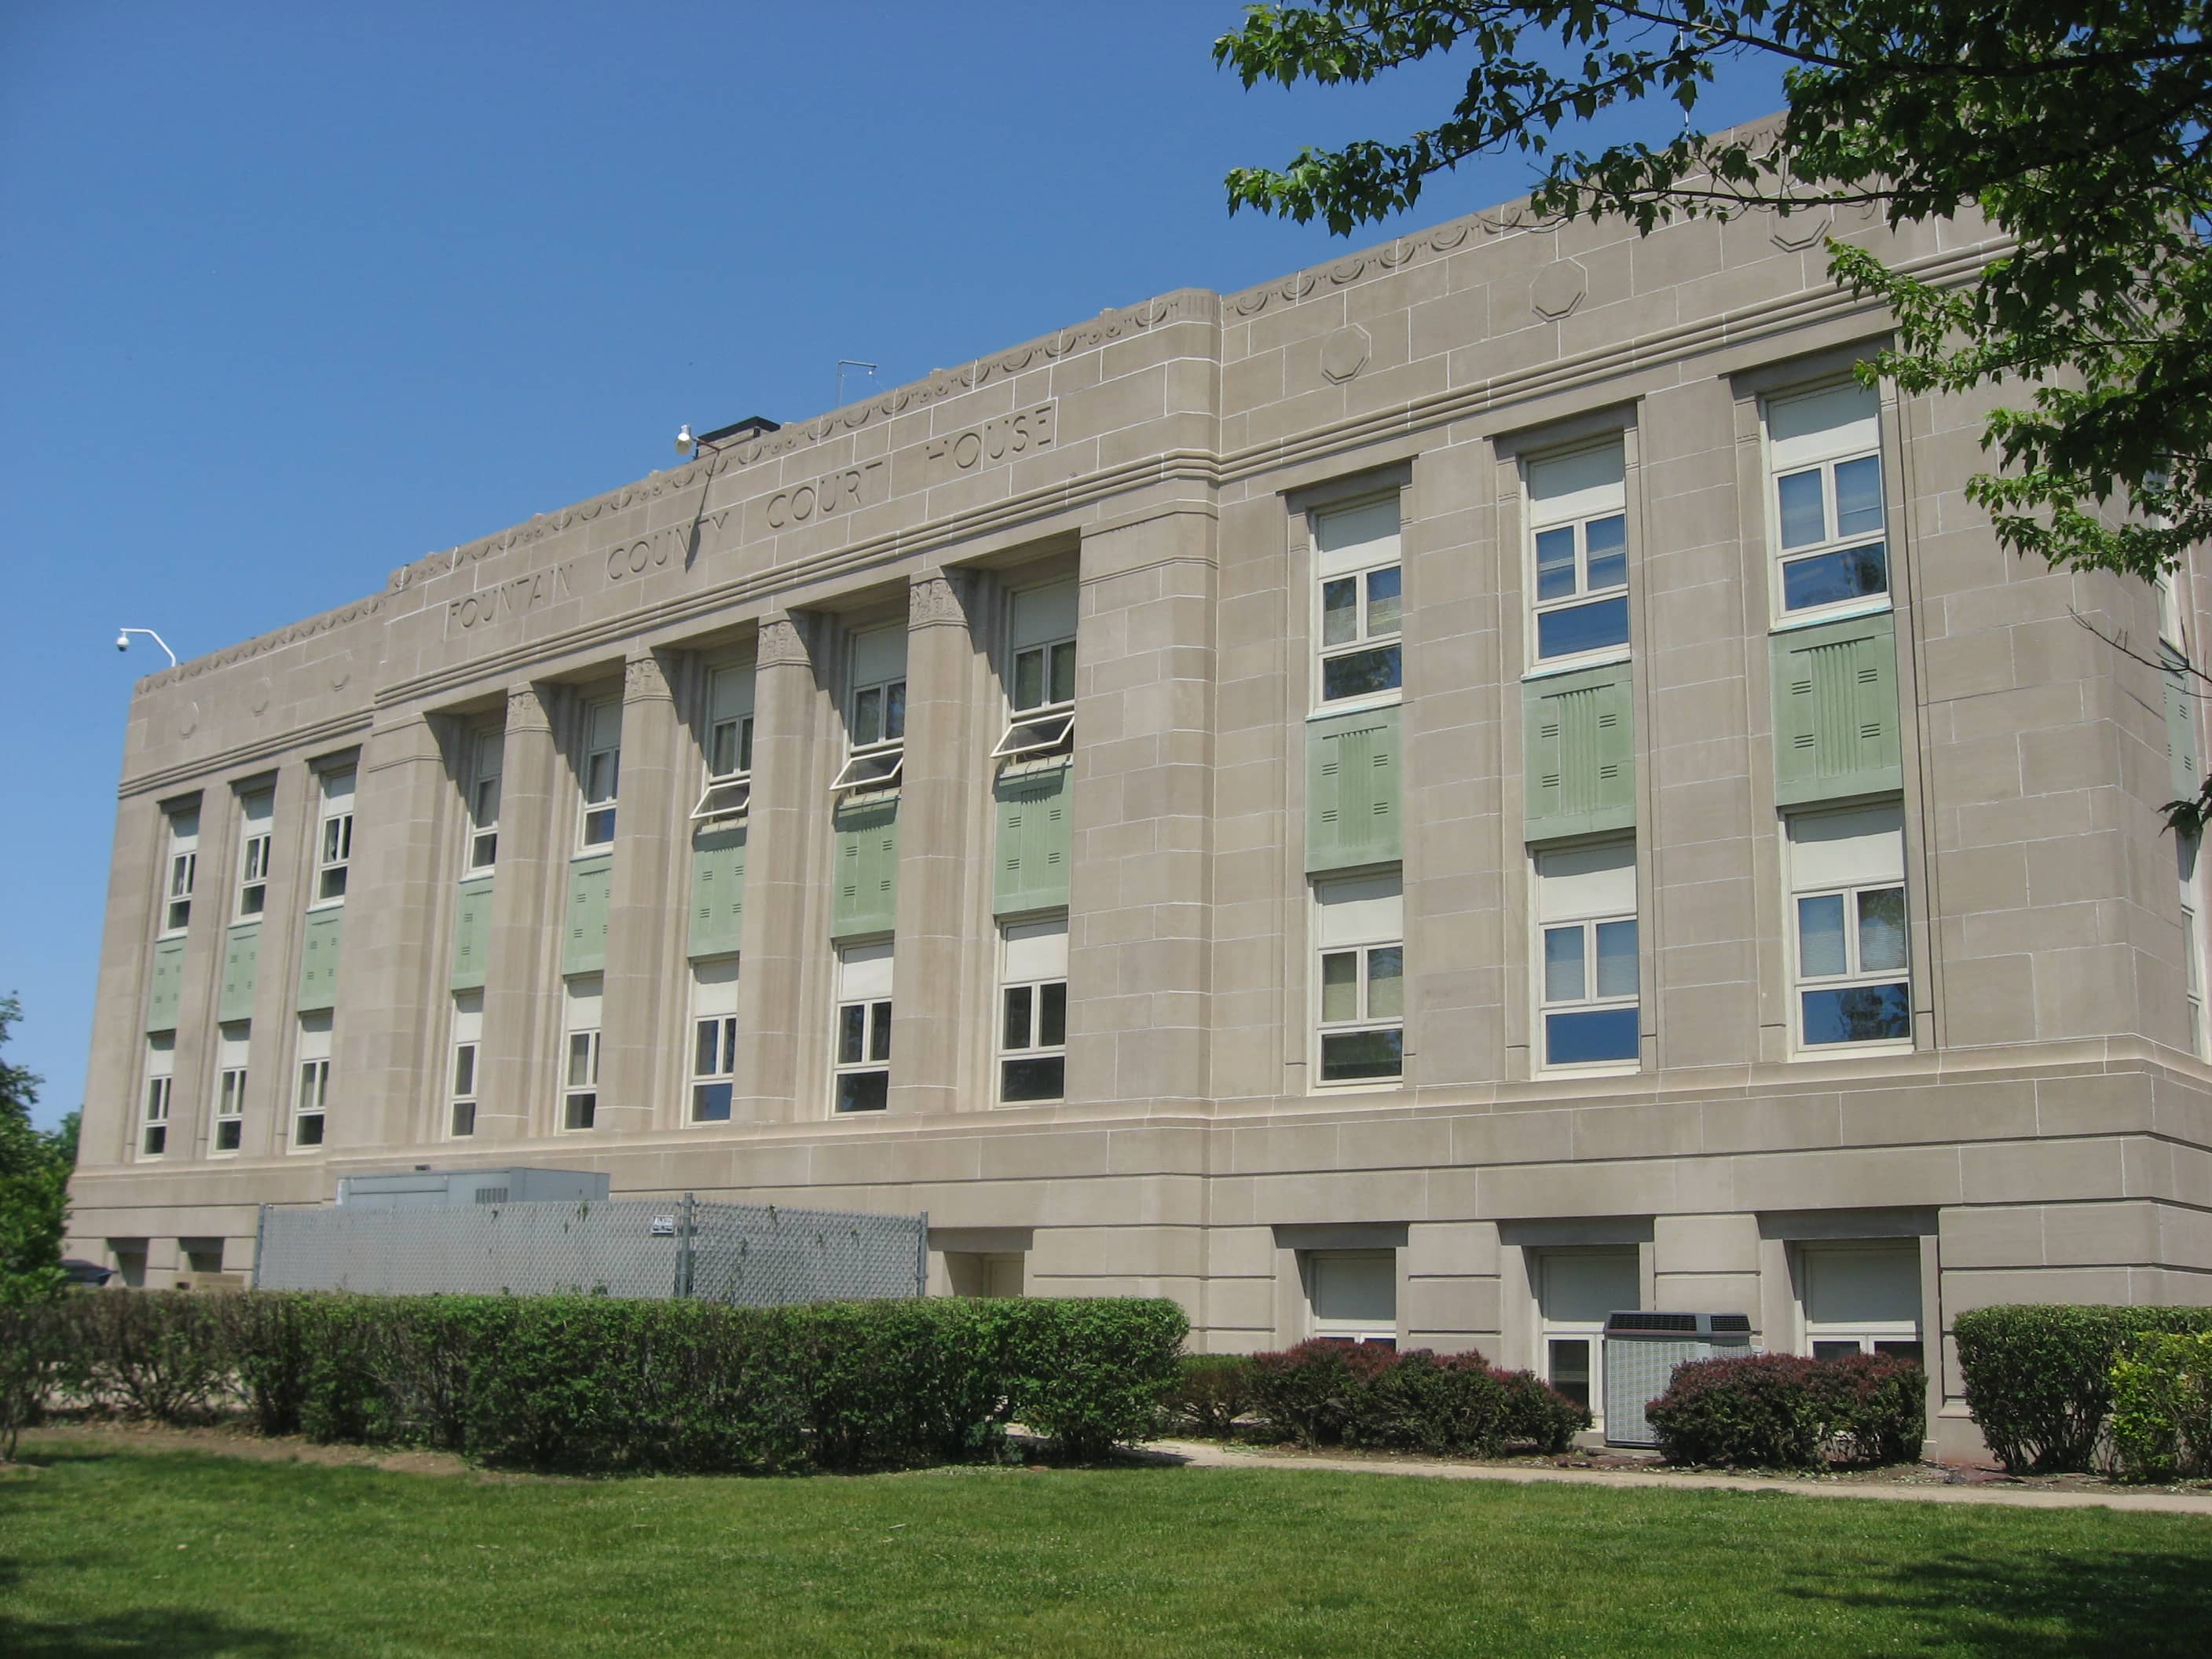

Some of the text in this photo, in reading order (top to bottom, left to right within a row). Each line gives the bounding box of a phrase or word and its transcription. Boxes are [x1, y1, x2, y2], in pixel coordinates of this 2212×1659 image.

[449, 405, 1052, 631] FOUNTAIN COUNTY COURT HOUSE
